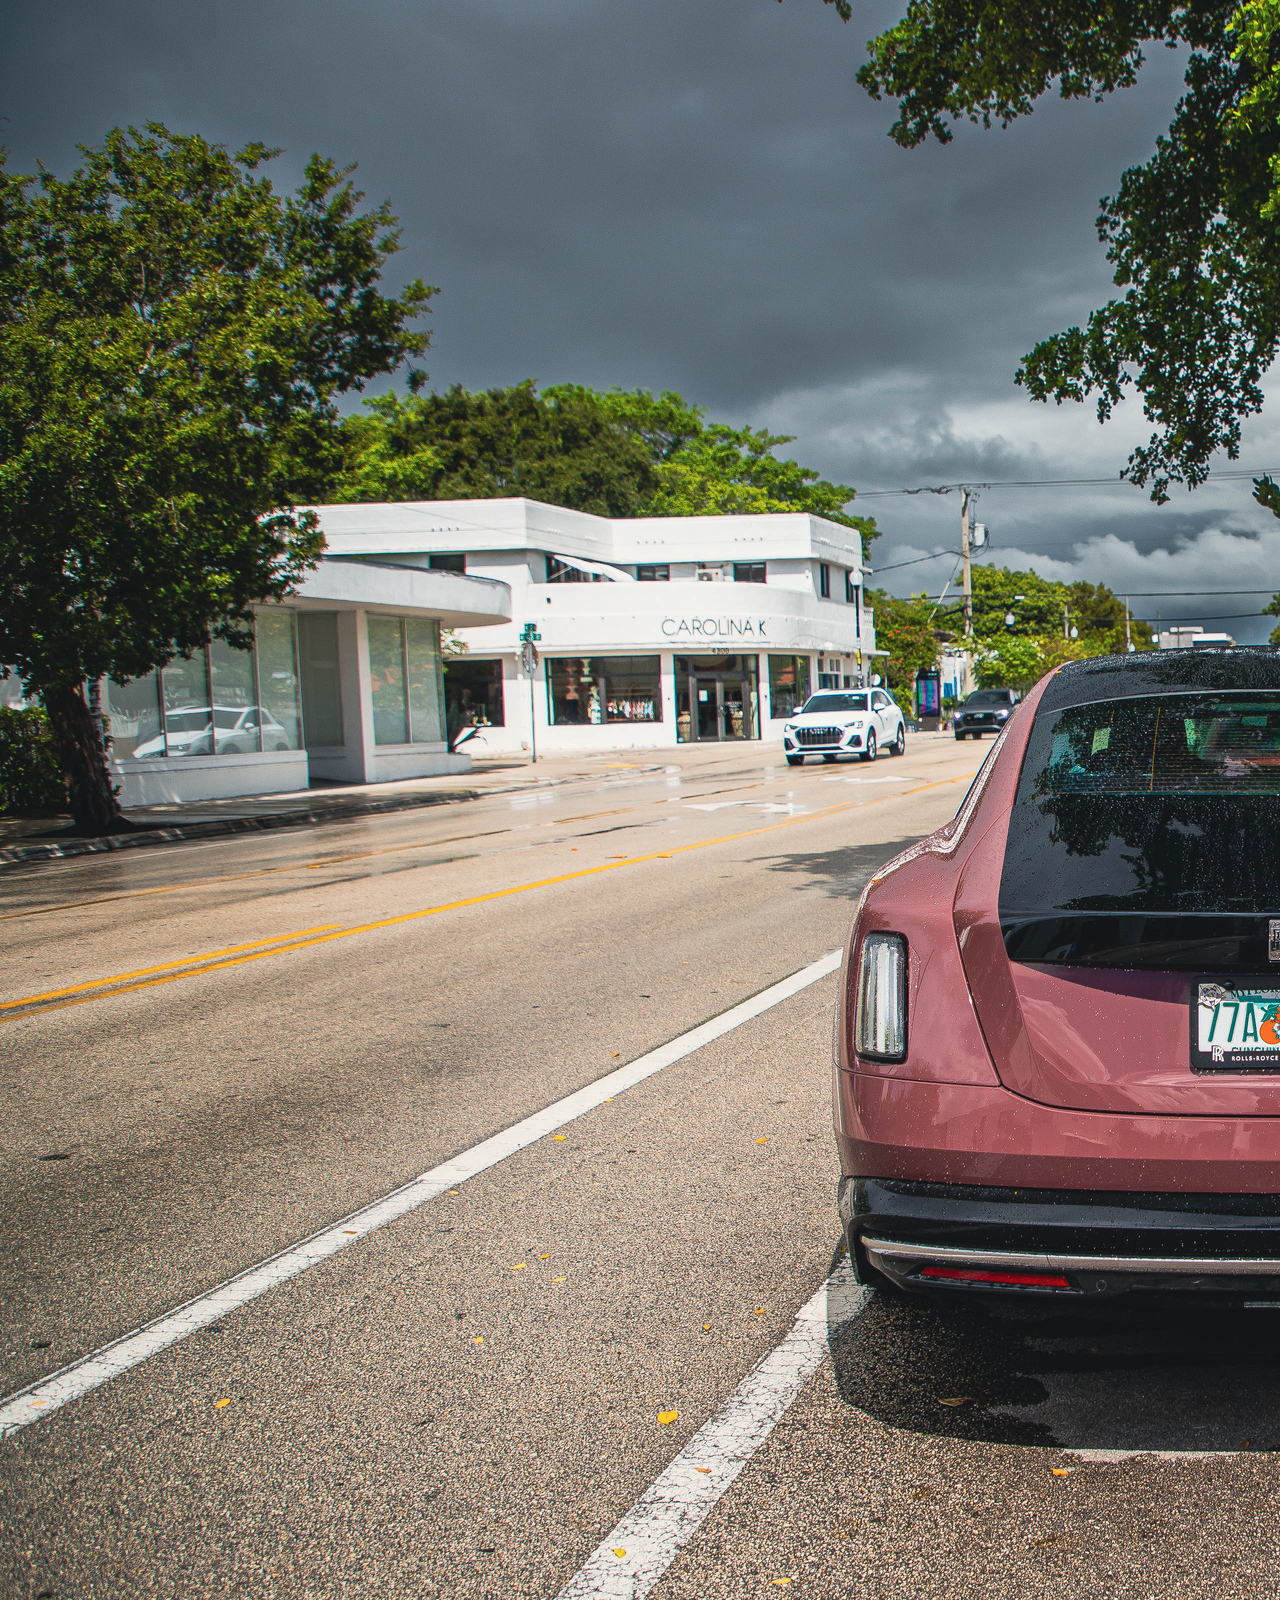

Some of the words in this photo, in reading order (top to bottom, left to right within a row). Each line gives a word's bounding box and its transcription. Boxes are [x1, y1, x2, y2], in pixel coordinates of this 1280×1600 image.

[661, 619, 755, 636] CAROLINA
[758, 620, 766, 636] K
[1207, 1002, 1259, 1042] 77A
